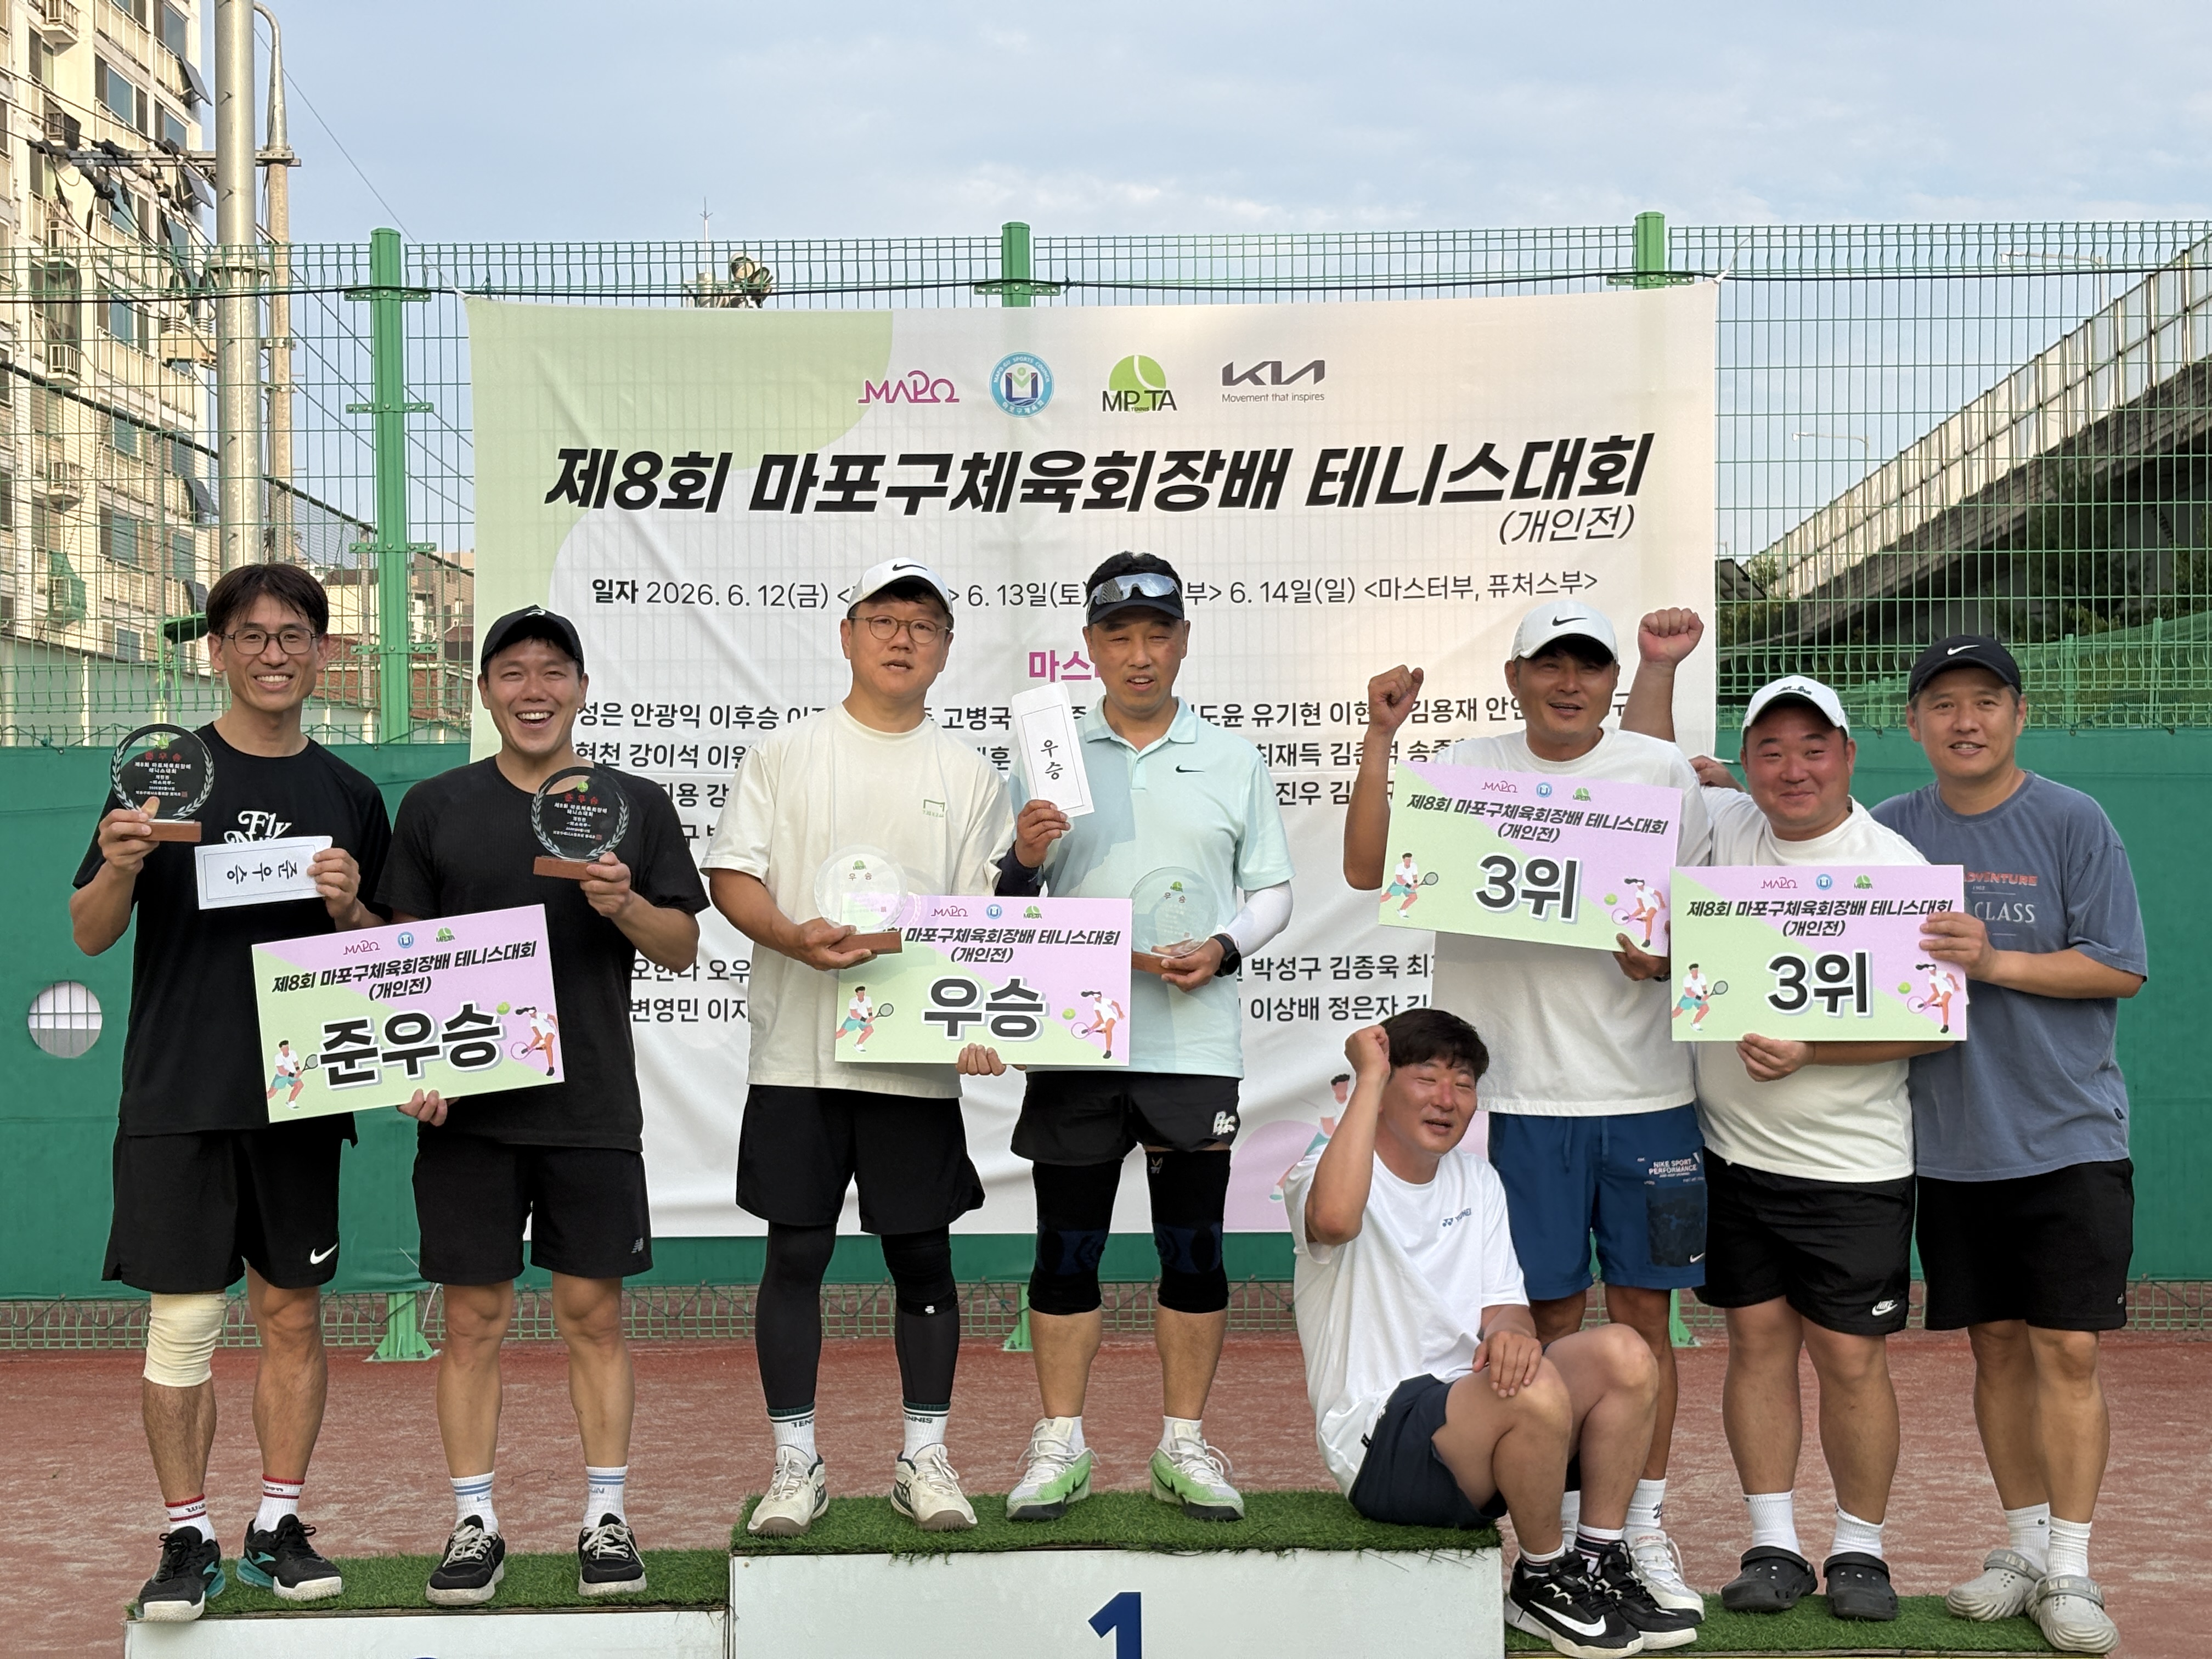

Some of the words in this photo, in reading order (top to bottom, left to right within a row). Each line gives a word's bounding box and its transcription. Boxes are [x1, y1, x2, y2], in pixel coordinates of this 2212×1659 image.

[994, 368, 1003, 382] MAPO
[1035, 362, 1050, 382] COUNCIL
[857, 370, 960, 404] MAPO
[1222, 393, 1269, 402] Movement
[1271, 393, 1289, 402] that
[1291, 392, 1324, 403] inspires
[545, 448, 733, 513] 제8회
[748, 448, 1294, 516] 마포구체육회장배
[1305, 432, 1655, 509] 테니스대회
[1499, 505, 1635, 545] (개인전)
[592, 579, 639, 604] 일자
[646, 582, 720, 606] 2026.
[728, 584, 750, 606] 6.
[758, 582, 828, 610] 12(금)
[968, 585, 989, 607] 6.
[1230, 582, 1252, 603] 6.
[1260, 577, 1355, 605] 14일(일)
[1364, 575, 1479, 602] <마스터부,
[1487, 571, 1598, 599] 퓨처스부>
[1029, 650, 1101, 682] 마스
[578, 702, 624, 726] 성은
[631, 703, 701, 729] 안광익
[709, 705, 780, 730] 이후승
[941, 706, 1012, 731] 고병국
[1190, 703, 1244, 727] 도윤
[1251, 702, 1321, 727] 유기현
[1330, 701, 1370, 725] 이현
[1412, 697, 1477, 724] 김용재
[575, 742, 621, 767] 현천
[629, 743, 699, 769] 강이석
[1041, 740, 1064, 780] 우승
[1276, 781, 1322, 806] 진우
[238, 811, 292, 839] Fly
[1407, 794, 1452, 813] 제8회
[1454, 798, 1582, 826] 마포구체육회장배
[1585, 812, 1668, 835] 테니스대회
[1497, 824, 1560, 843] (개인전)
[1476, 855, 1577, 919] 3위
[1686, 900, 1731, 917] 제8회
[1735, 900, 1867, 917] 마포구체육회장배
[1869, 899, 1953, 916] 테니스대회
[1974, 901, 2035, 923] CLASS
[905, 928, 1036, 944] 마포구체육회장배
[1037, 929, 1121, 946] 테니스대회
[1782, 920, 1846, 937] (개인전)
[272, 972, 316, 993] 제8회
[320, 952, 450, 987] 마포구체육회장배
[454, 940, 538, 967] 테니스대회
[950, 946, 1014, 963] (개인전)
[707, 960, 751, 983] 오우
[1251, 956, 1322, 982] 박성구
[1329, 955, 1400, 980] 김종욱
[1768, 951, 1867, 1013] 3위
[368, 976, 432, 1000] (개인전)
[631, 998, 699, 1023] 변영민
[924, 978, 1043, 1037] 우승
[1250, 996, 1319, 1022] 이상배
[320, 1003, 500, 1086] 준우승
[1649, 1164, 1697, 1175] PERFORMANCE
[1671, 1158, 1691, 1167] SPORT
[1088, 1592, 1142, 1659] 1
